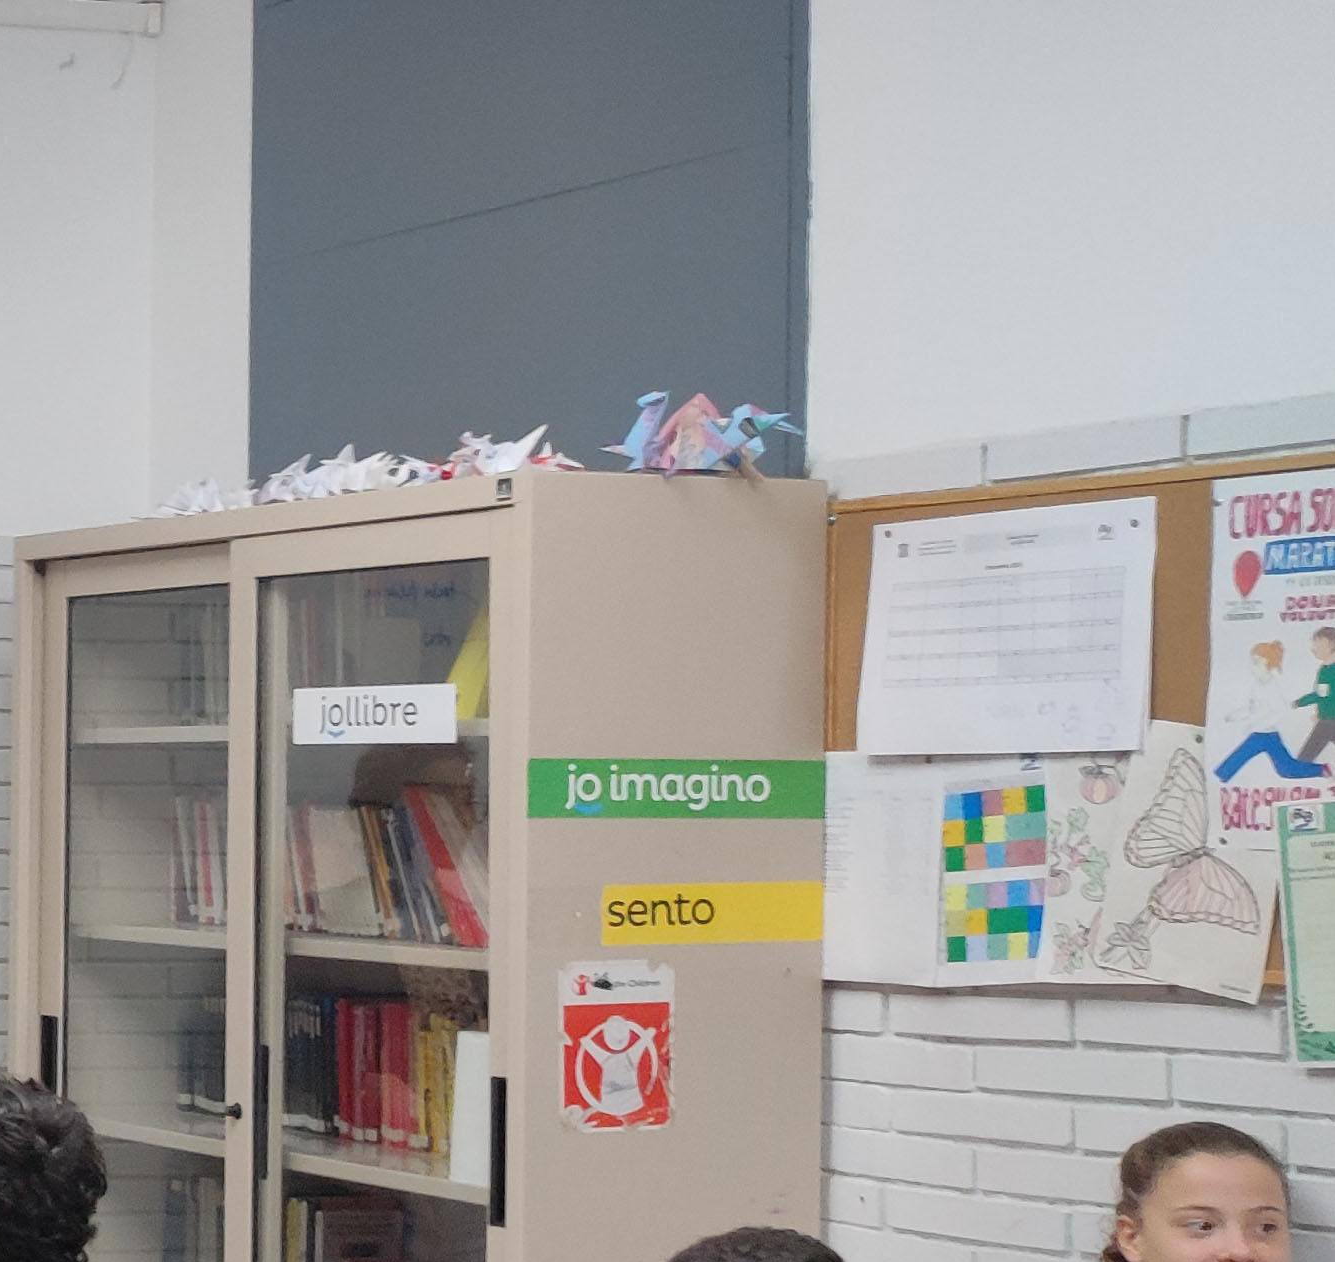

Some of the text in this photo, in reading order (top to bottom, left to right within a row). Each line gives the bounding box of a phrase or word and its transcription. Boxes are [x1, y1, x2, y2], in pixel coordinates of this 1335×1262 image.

[1229, 491, 1302, 539] CURSA
[565, 763, 772, 812] jo imagino
[607, 893, 715, 927] sento
